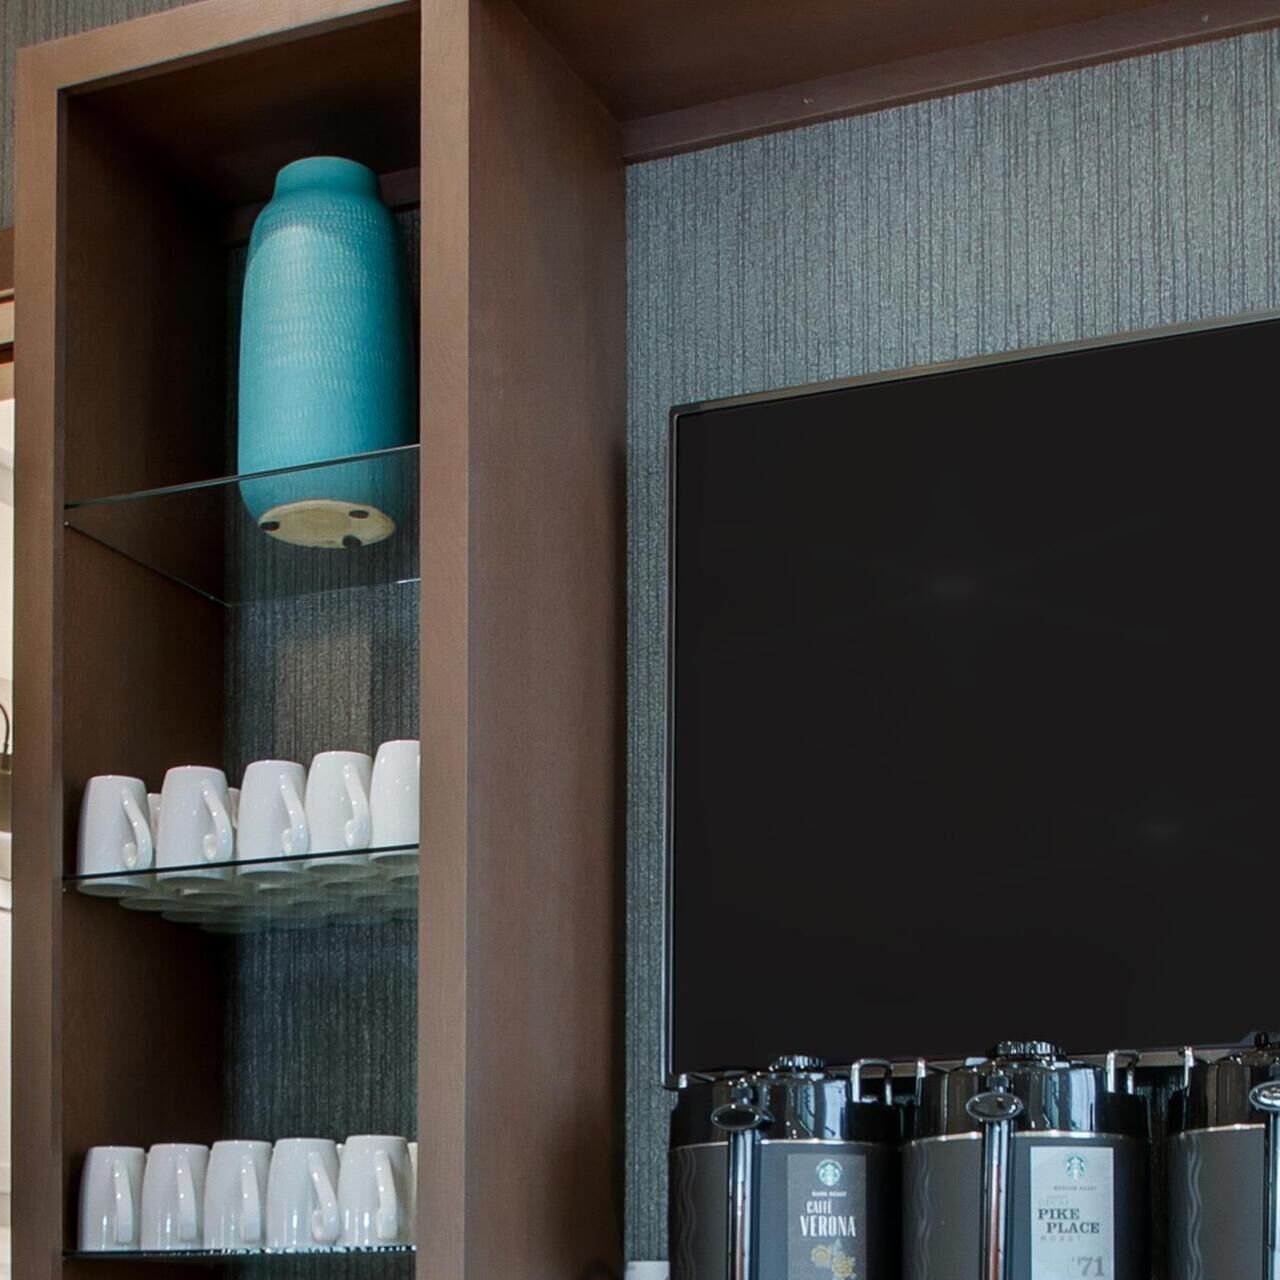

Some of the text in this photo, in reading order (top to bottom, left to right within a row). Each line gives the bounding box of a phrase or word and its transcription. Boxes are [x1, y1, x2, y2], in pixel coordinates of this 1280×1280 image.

[1037, 1208, 1080, 1220] PIKE
[800, 1215, 856, 1237] VERONA
[1046, 1221, 1100, 1234] PLACE
